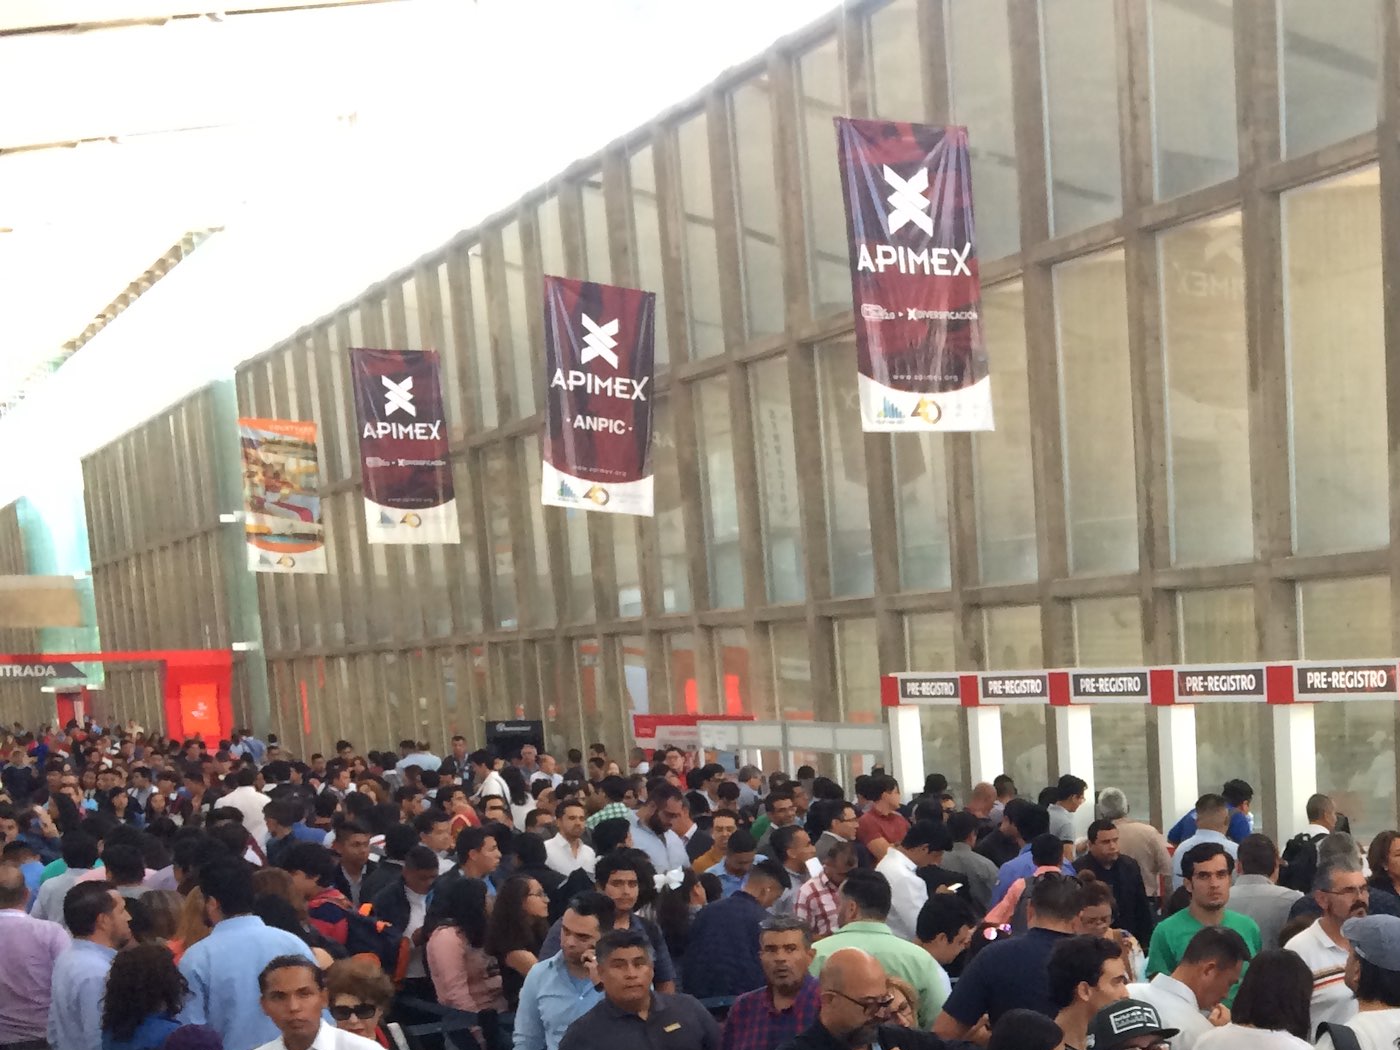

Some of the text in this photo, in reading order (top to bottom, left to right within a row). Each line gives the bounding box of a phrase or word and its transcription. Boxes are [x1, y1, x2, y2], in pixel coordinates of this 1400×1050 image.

[857, 242, 972, 276] APIMEX
[551, 367, 649, 401] APIMEX
[363, 420, 441, 440] APIMEX
[573, 415, 626, 435] ANPIC
[906, 681, 955, 696] PRE-REGISTRO
[988, 678, 1042, 694] PRE-REGISTRO
[1080, 676, 1141, 693] PRE-REGISTRO
[1186, 674, 1256, 691] PRE-REGISTRO
[1307, 669, 1387, 689] PRE-REGISTRO
